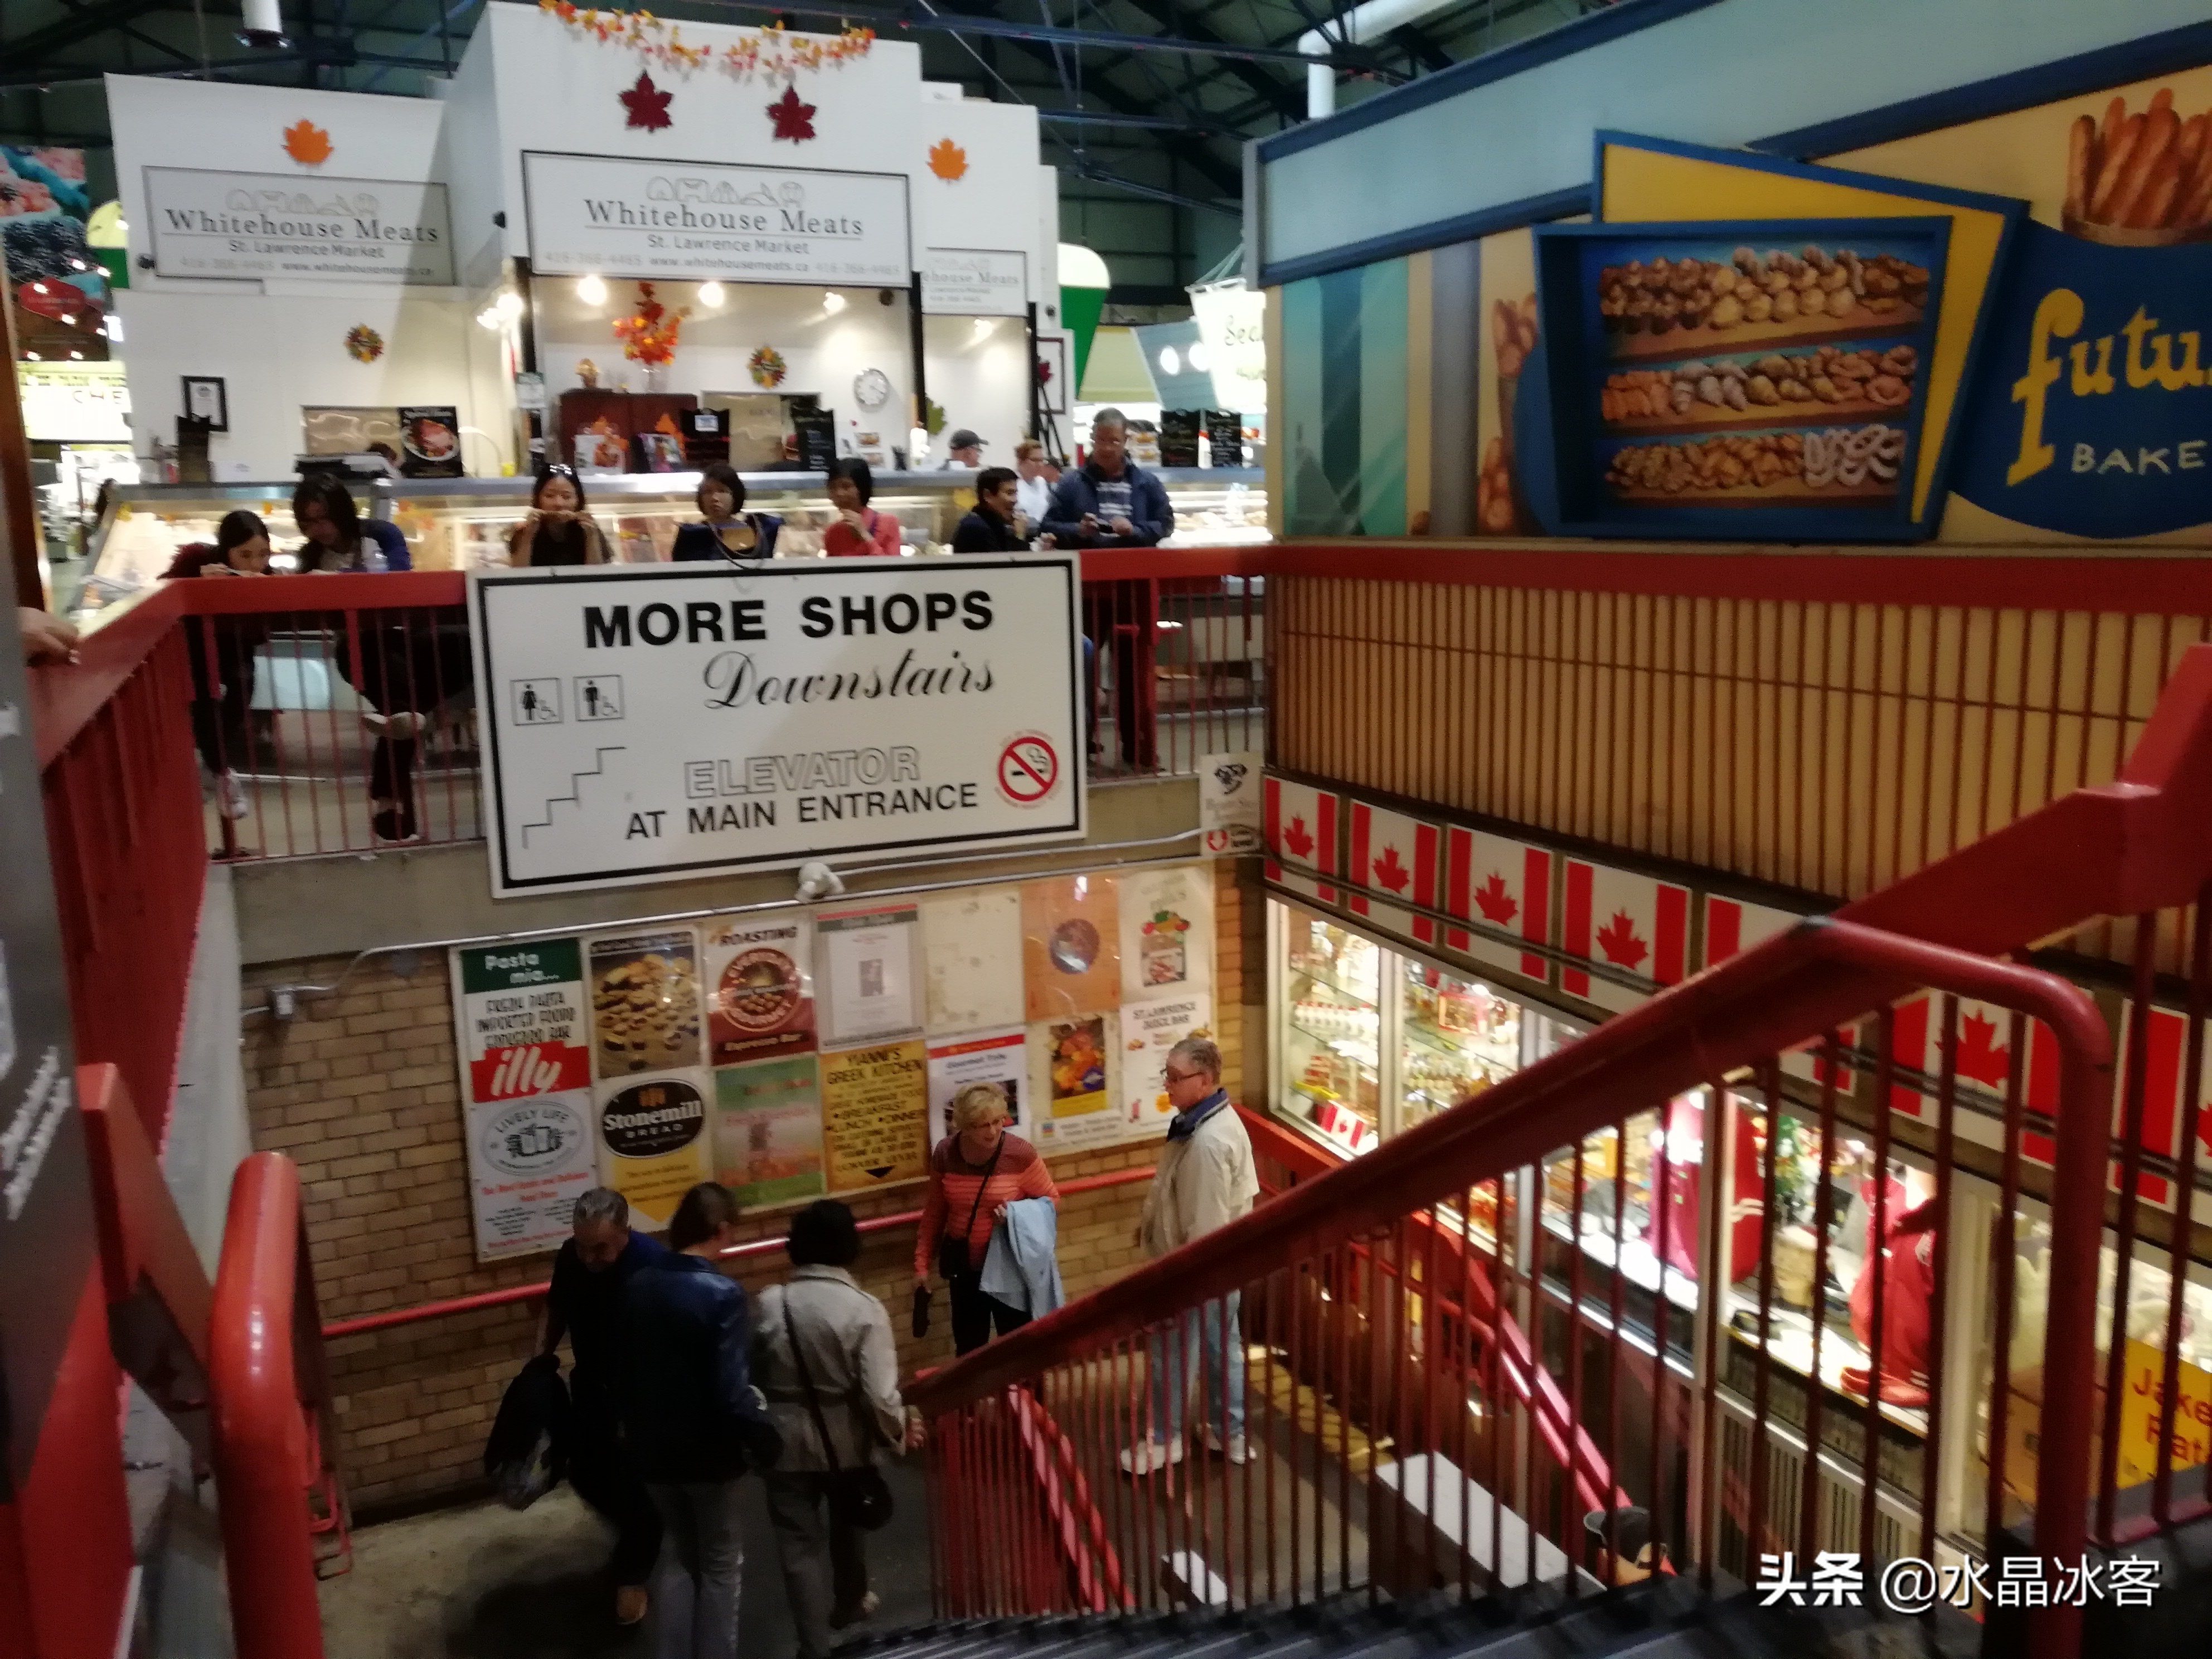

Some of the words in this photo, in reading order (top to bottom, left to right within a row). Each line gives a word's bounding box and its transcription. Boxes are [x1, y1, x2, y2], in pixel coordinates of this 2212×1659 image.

[164, 209, 343, 238] Whitehouse
[353, 218, 438, 242] Meats
[584, 199, 768, 231] Whitehouse
[779, 209, 864, 235] Meats
[254, 240, 328, 255] Lawrence
[332, 244, 385, 258] Market
[647, 234, 670, 248] St.
[675, 235, 750, 251] Lawrence
[754, 239, 809, 254] Market
[2007, 288, 2212, 486] futu
[2070, 439, 2208, 476] BAKE
[583, 600, 768, 648] MORE
[800, 590, 993, 638] SHOPS
[703, 648, 994, 710] Downstairs
[683, 745, 921, 799] ELEVATOR
[625, 810, 667, 840] AT
[687, 801, 776, 834] MAIN
[797, 782, 978, 823] ENTRANCE
[484, 952, 539, 971] Pasta
[491, 1046, 562, 1097] illy
[604, 1100, 702, 1131] Stonemill
[625, 1123, 683, 1139] BREAD
